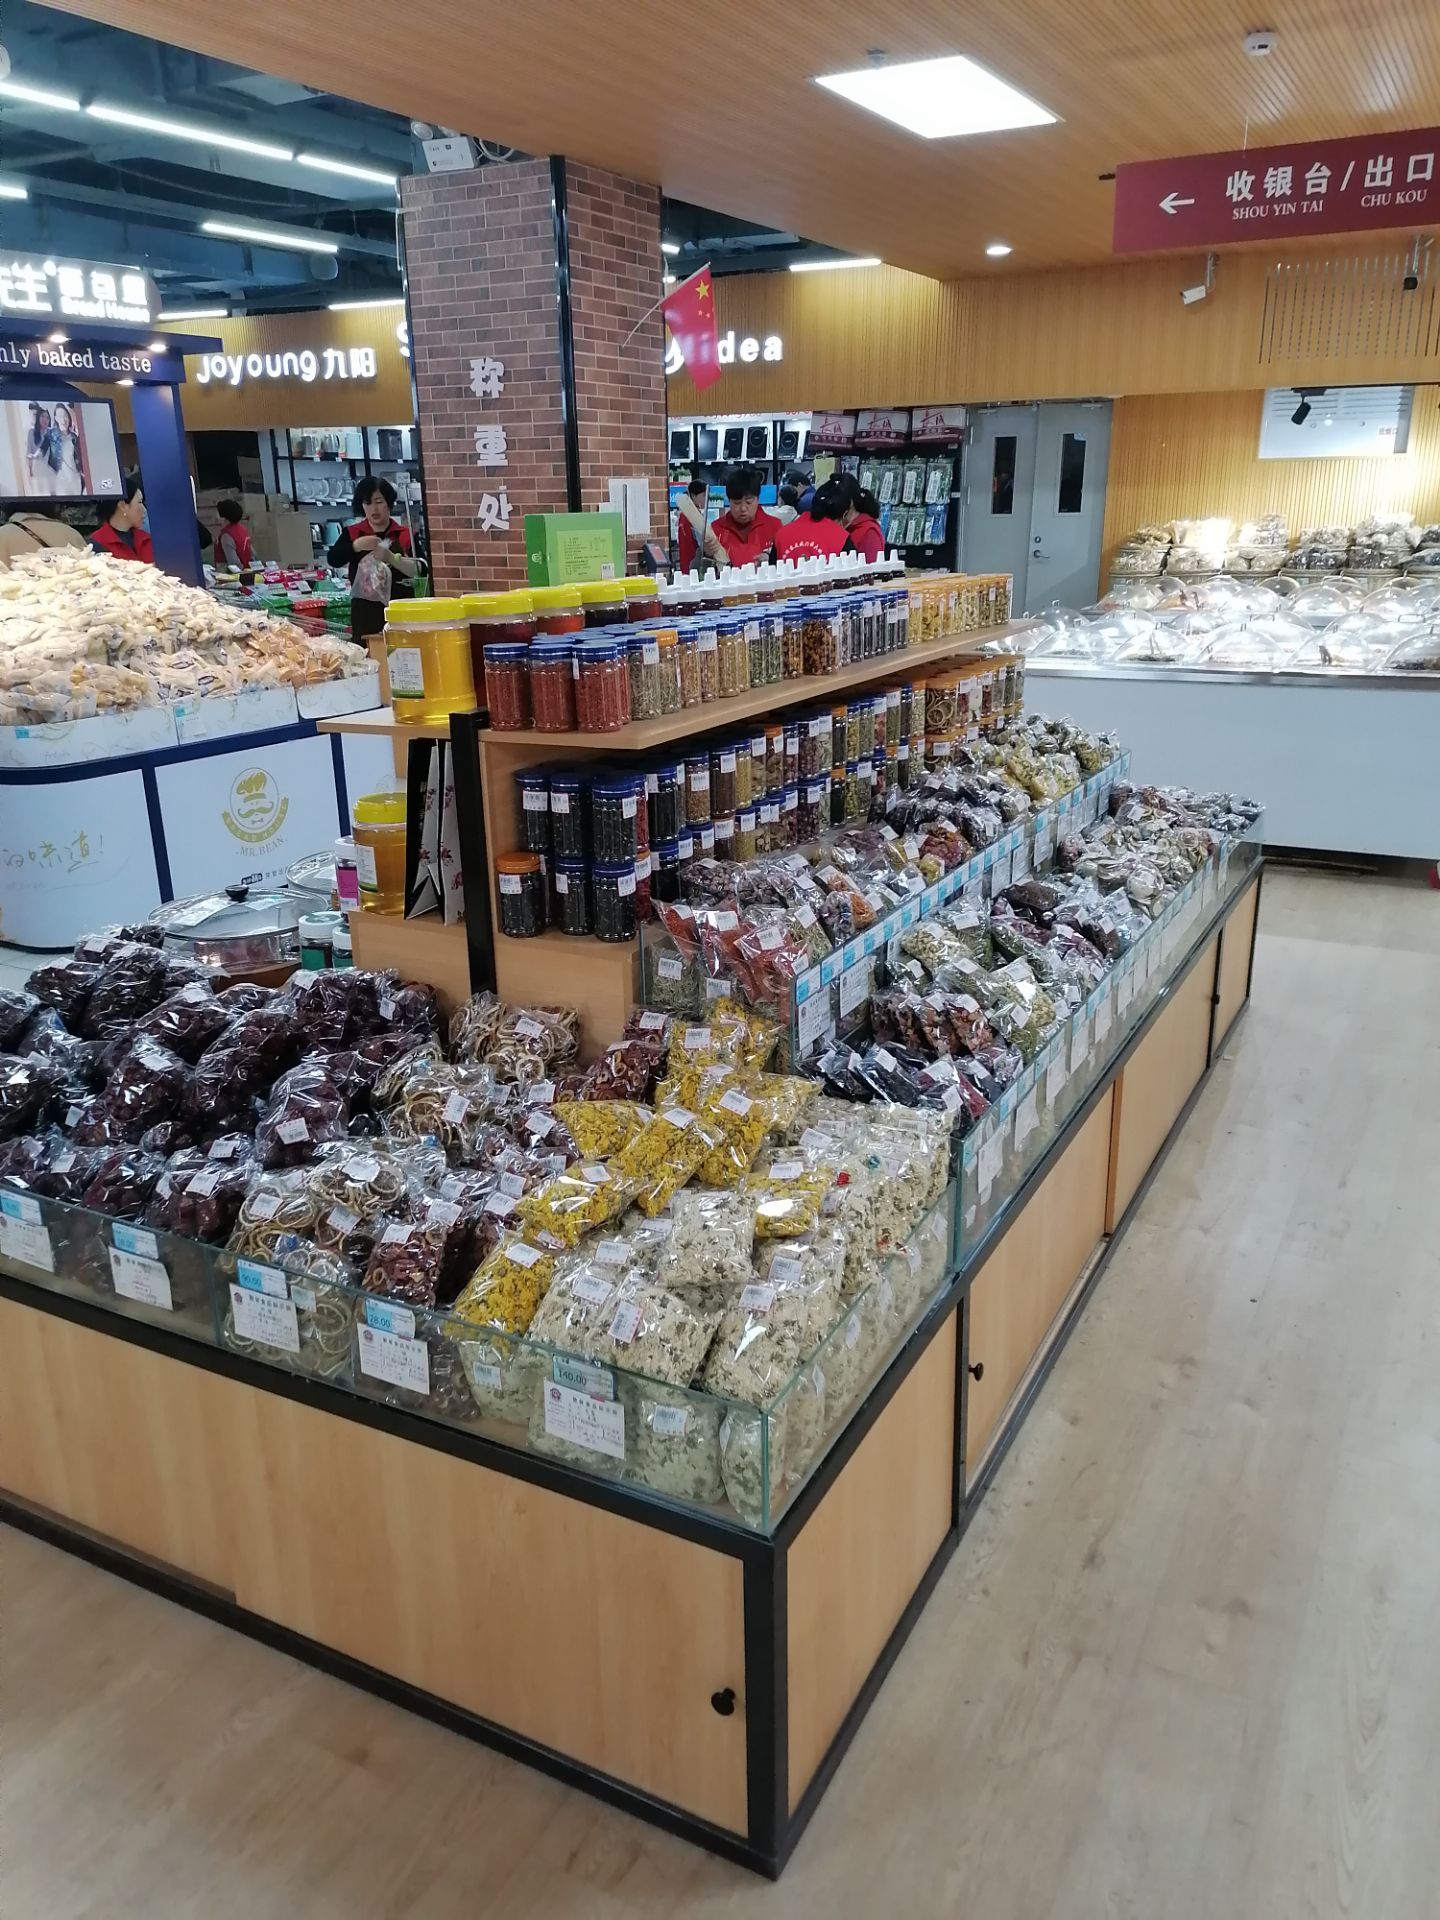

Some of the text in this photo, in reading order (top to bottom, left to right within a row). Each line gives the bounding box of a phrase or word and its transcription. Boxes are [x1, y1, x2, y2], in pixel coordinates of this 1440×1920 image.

[1226, 152, 1434, 203] 收银台/出口
[1232, 199, 1324, 220] SHOU YIN TAI
[1361, 189, 1428, 208] CHU KOU
[37, 344, 94, 369] baked
[99, 351, 152, 373] taste
[323, 347, 377, 380] 九阳
[469, 356, 513, 532] 称重处
[369, 1314, 390, 1328] 28.00
